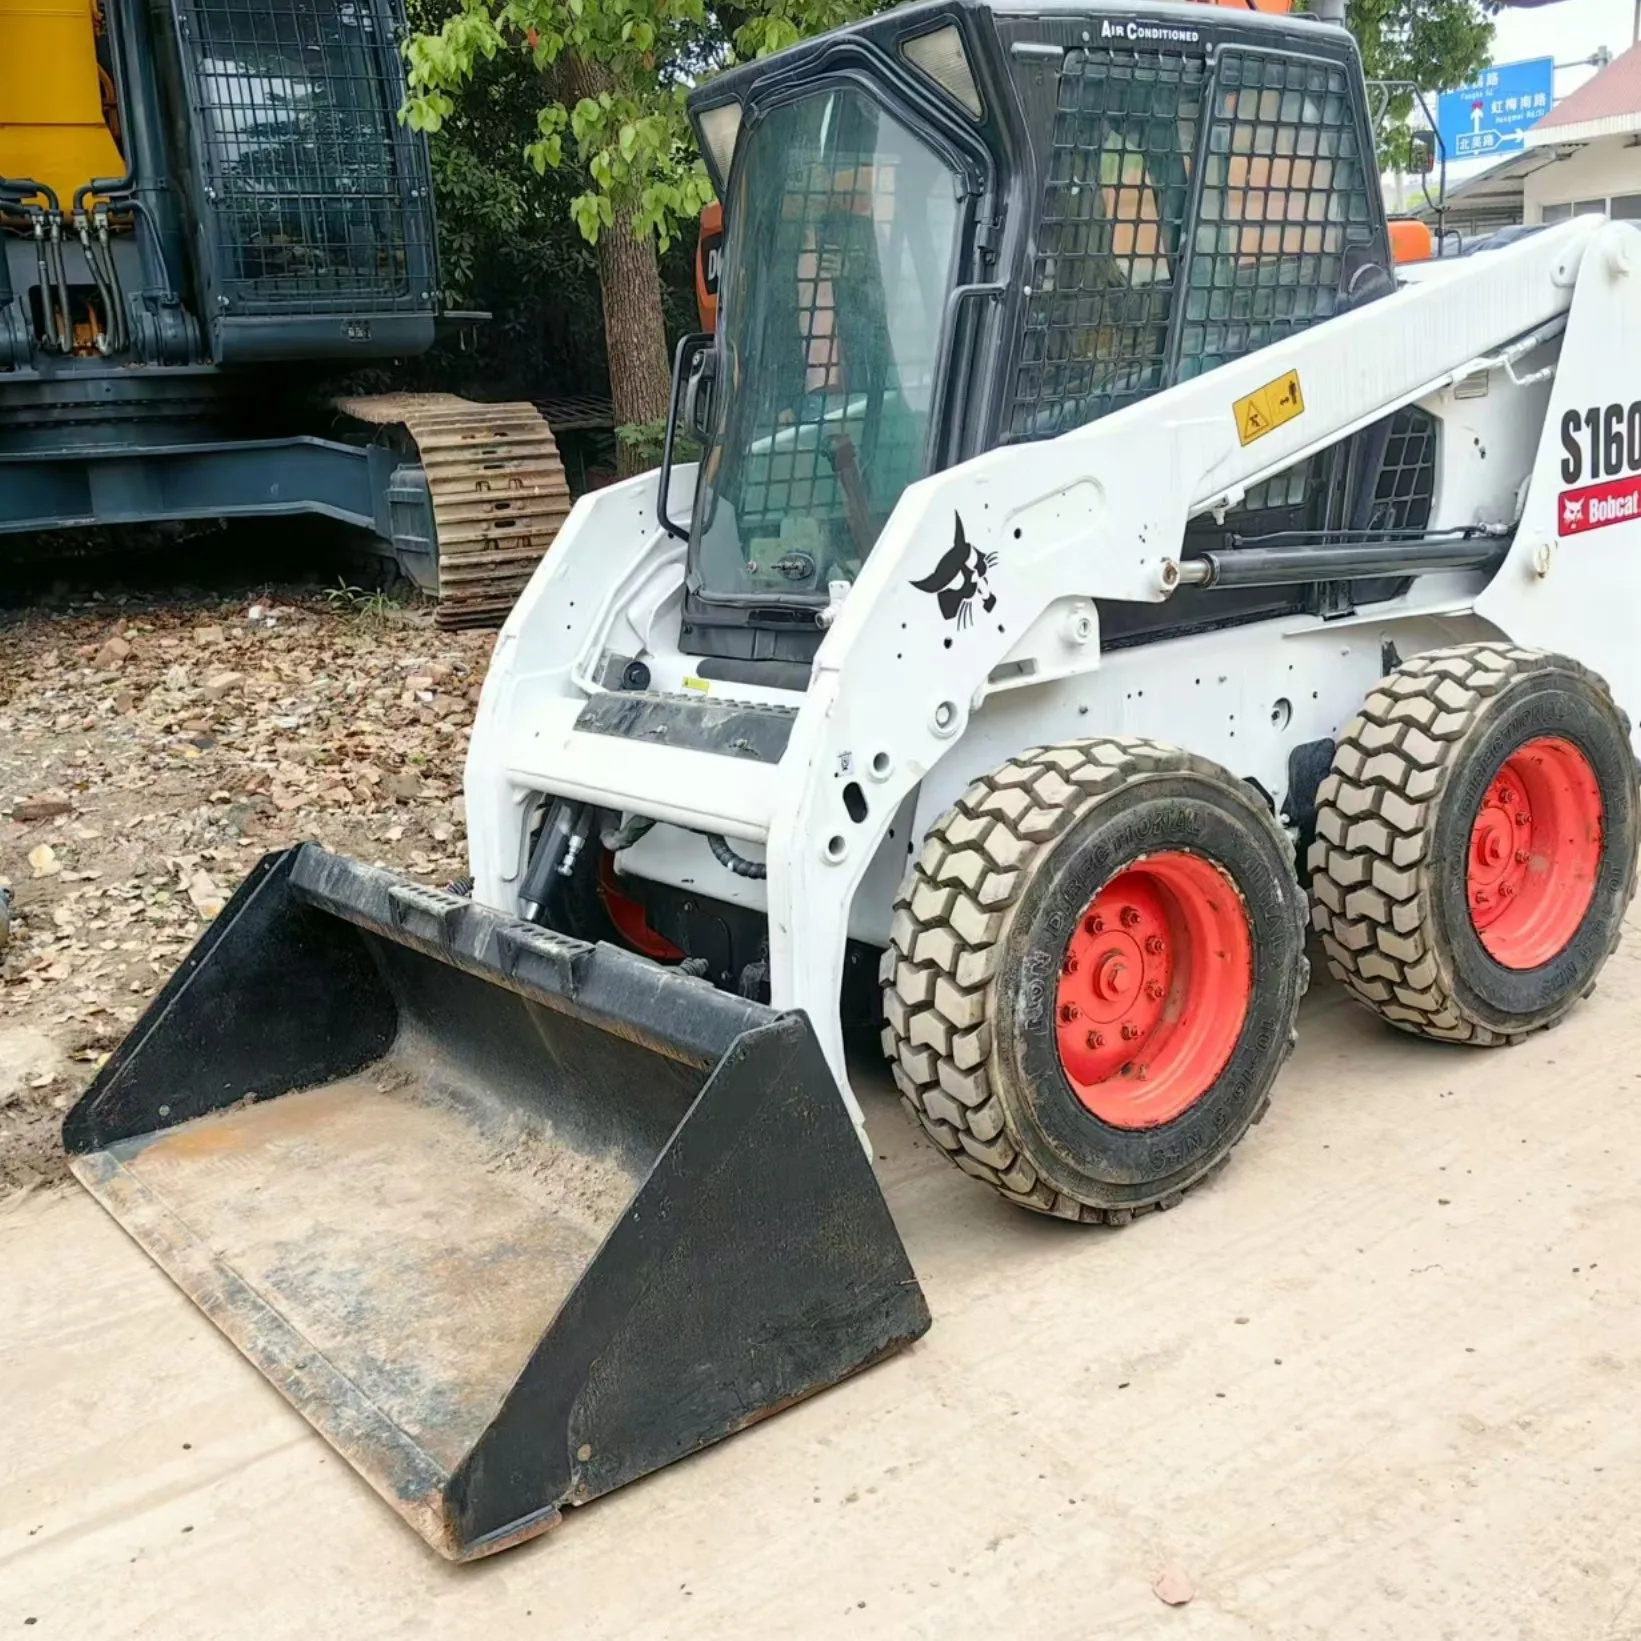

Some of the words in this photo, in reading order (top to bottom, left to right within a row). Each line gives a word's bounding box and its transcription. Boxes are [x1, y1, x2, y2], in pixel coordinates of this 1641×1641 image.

[1491, 92, 1547, 114] 虹梅南路
[1560, 400, 1641, 485] S160
[1588, 490, 1639, 523] Bobcat
